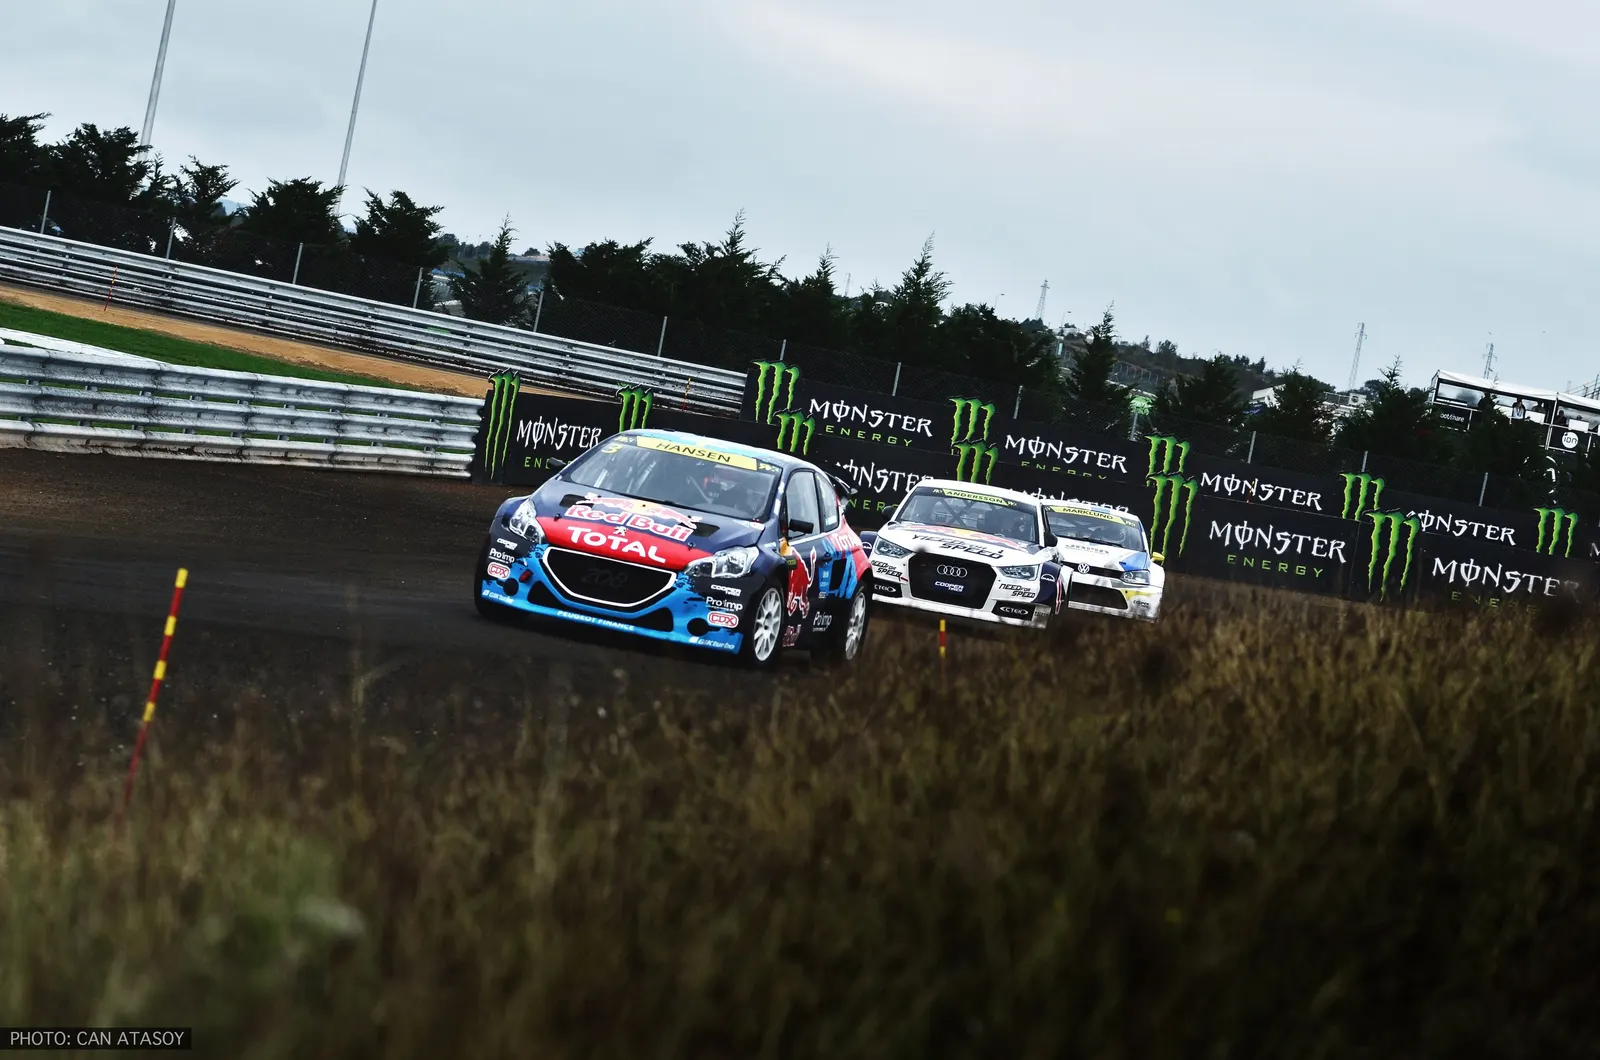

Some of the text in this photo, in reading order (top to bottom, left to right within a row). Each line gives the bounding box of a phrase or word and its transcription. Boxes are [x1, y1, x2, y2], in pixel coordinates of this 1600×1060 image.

[825, 424, 913, 447] ENERGY
[656, 442, 731, 463] HANSEN
[946, 490, 1004, 504] ANDERSSON
[1062, 507, 1114, 520] MARKLUND
[564, 504, 694, 542] Red Bull
[1406, 509, 1516, 546] ONSTER
[567, 526, 667, 564] TOTAL
[939, 542, 1004, 559] SPEED
[489, 564, 508, 579] CDX
[876, 567, 903, 577] SPEED
[1227, 554, 1324, 578] ENERGY
[934, 580, 965, 589] COOPER
[999, 583, 1021, 591] NEED
[1011, 590, 1036, 598] SPEED
[557, 610, 636, 631] PEUGEOT FINANCE
[711, 614, 736, 627] CDX
